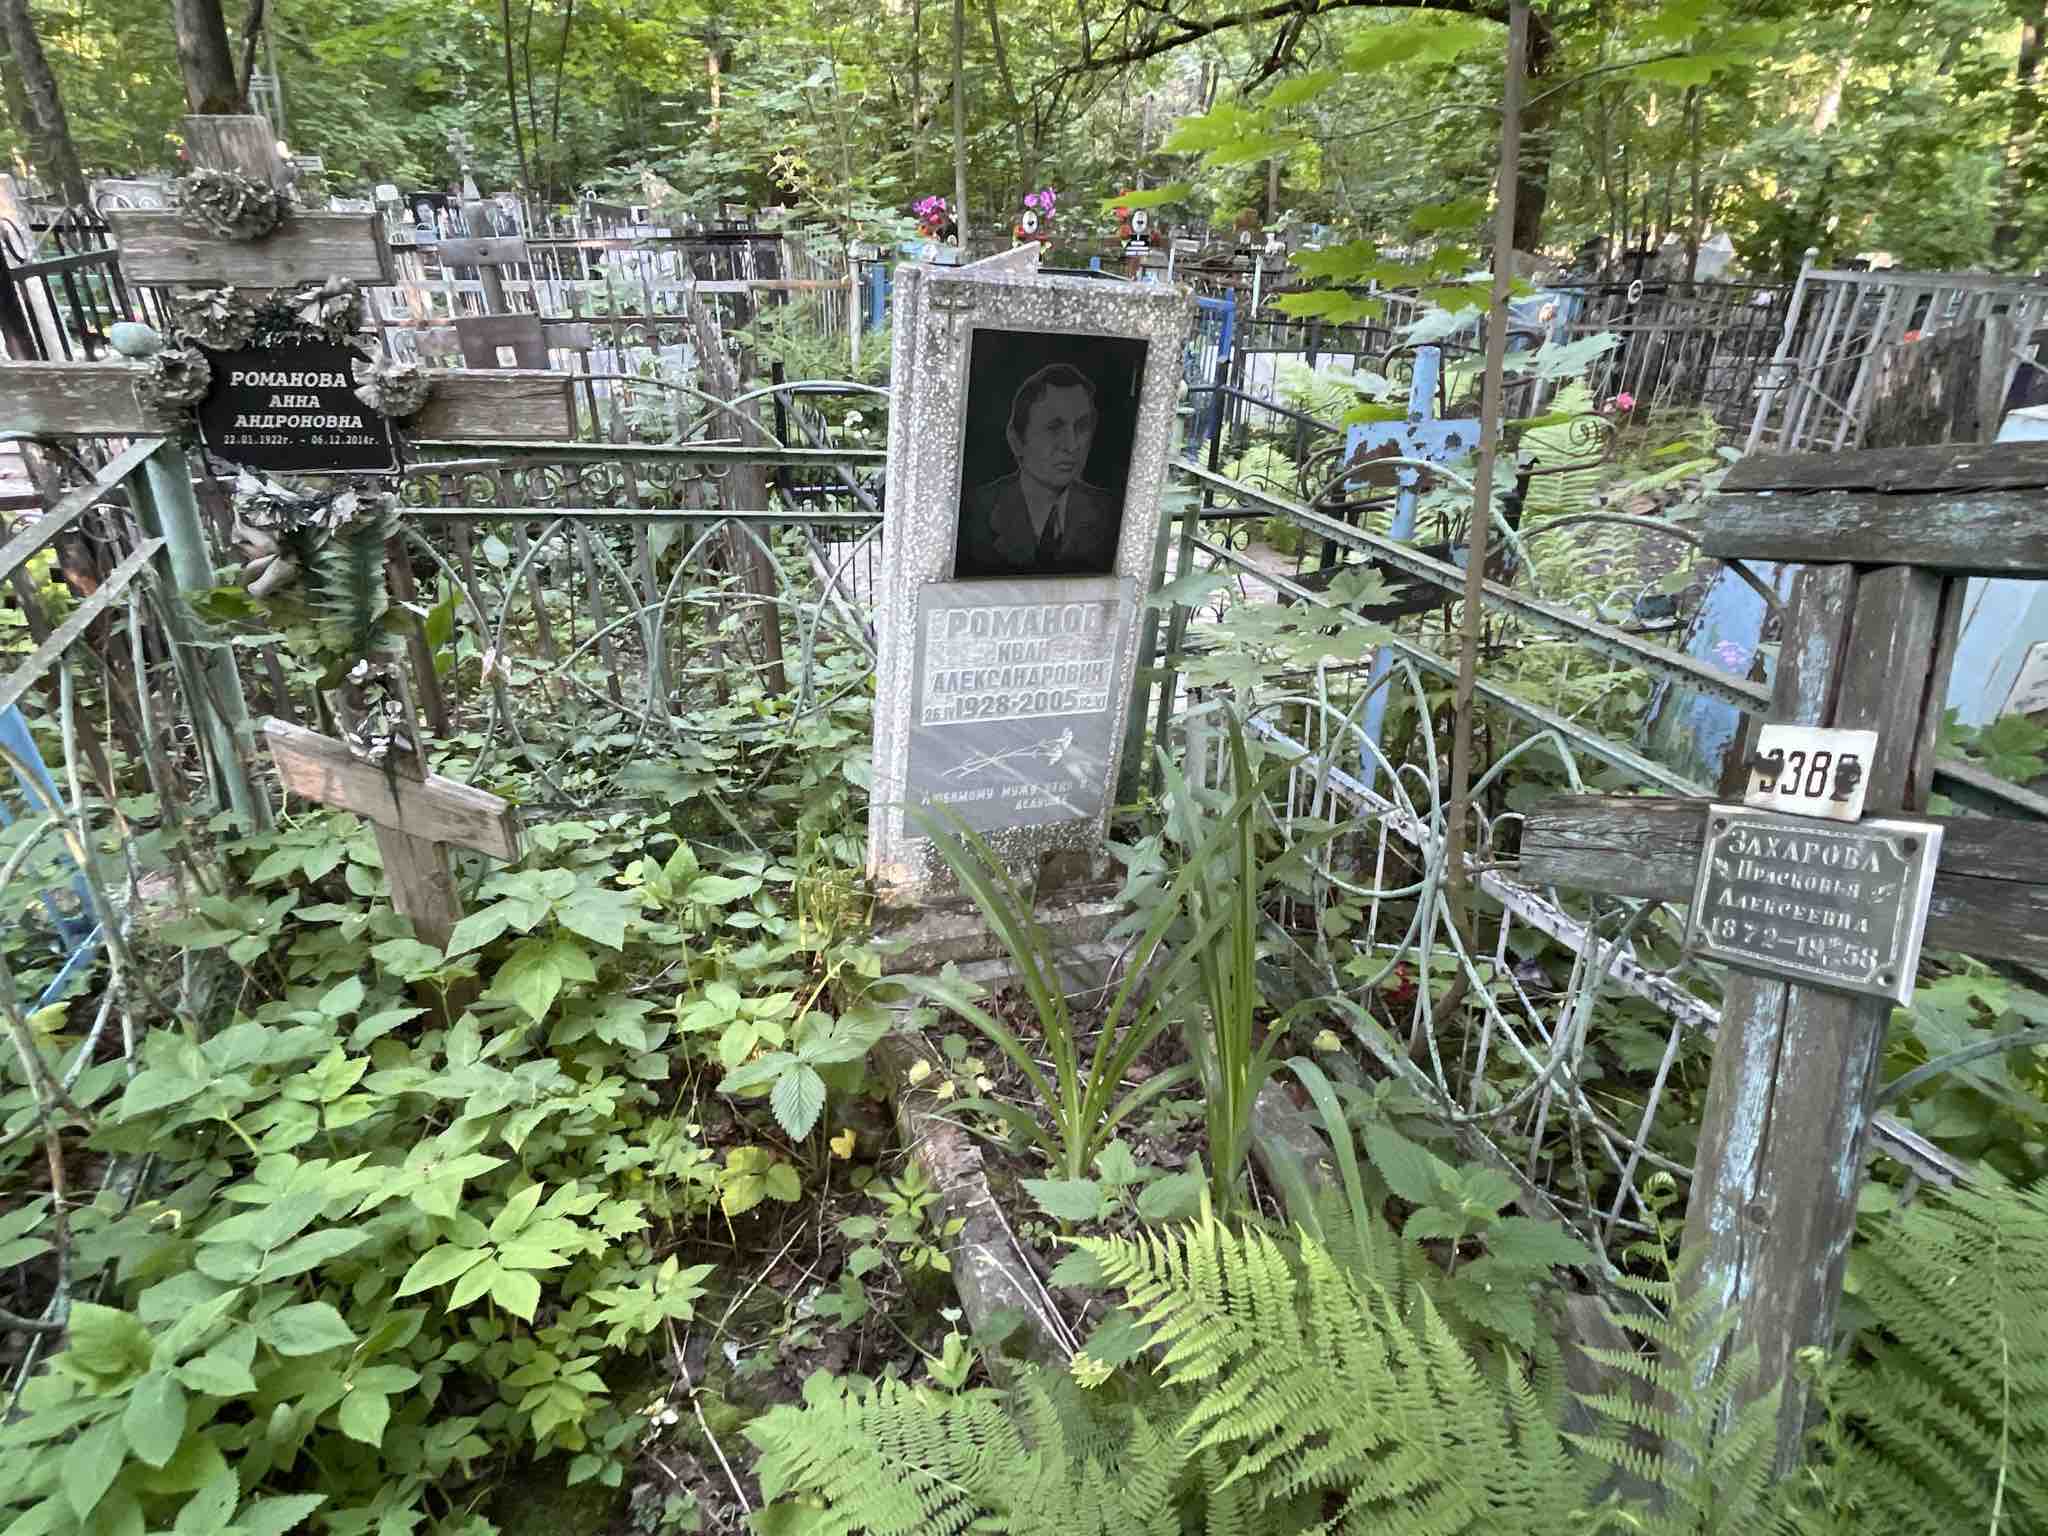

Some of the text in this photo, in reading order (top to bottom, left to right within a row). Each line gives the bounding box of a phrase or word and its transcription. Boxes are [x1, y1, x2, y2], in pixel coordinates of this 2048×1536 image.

[230, 371, 348, 388] РОМАНОВА
[268, 394, 321, 408] АННА
[233, 414, 363, 429] АНДРОНОВНА
[946, 604, 1101, 637] РОМАНОВ
[997, 640, 1050, 663] ИВАН
[932, 662, 1106, 693] АЛЕКСАНДРОВИЧ
[1728, 830, 1880, 873] ЗАХАРОВА
